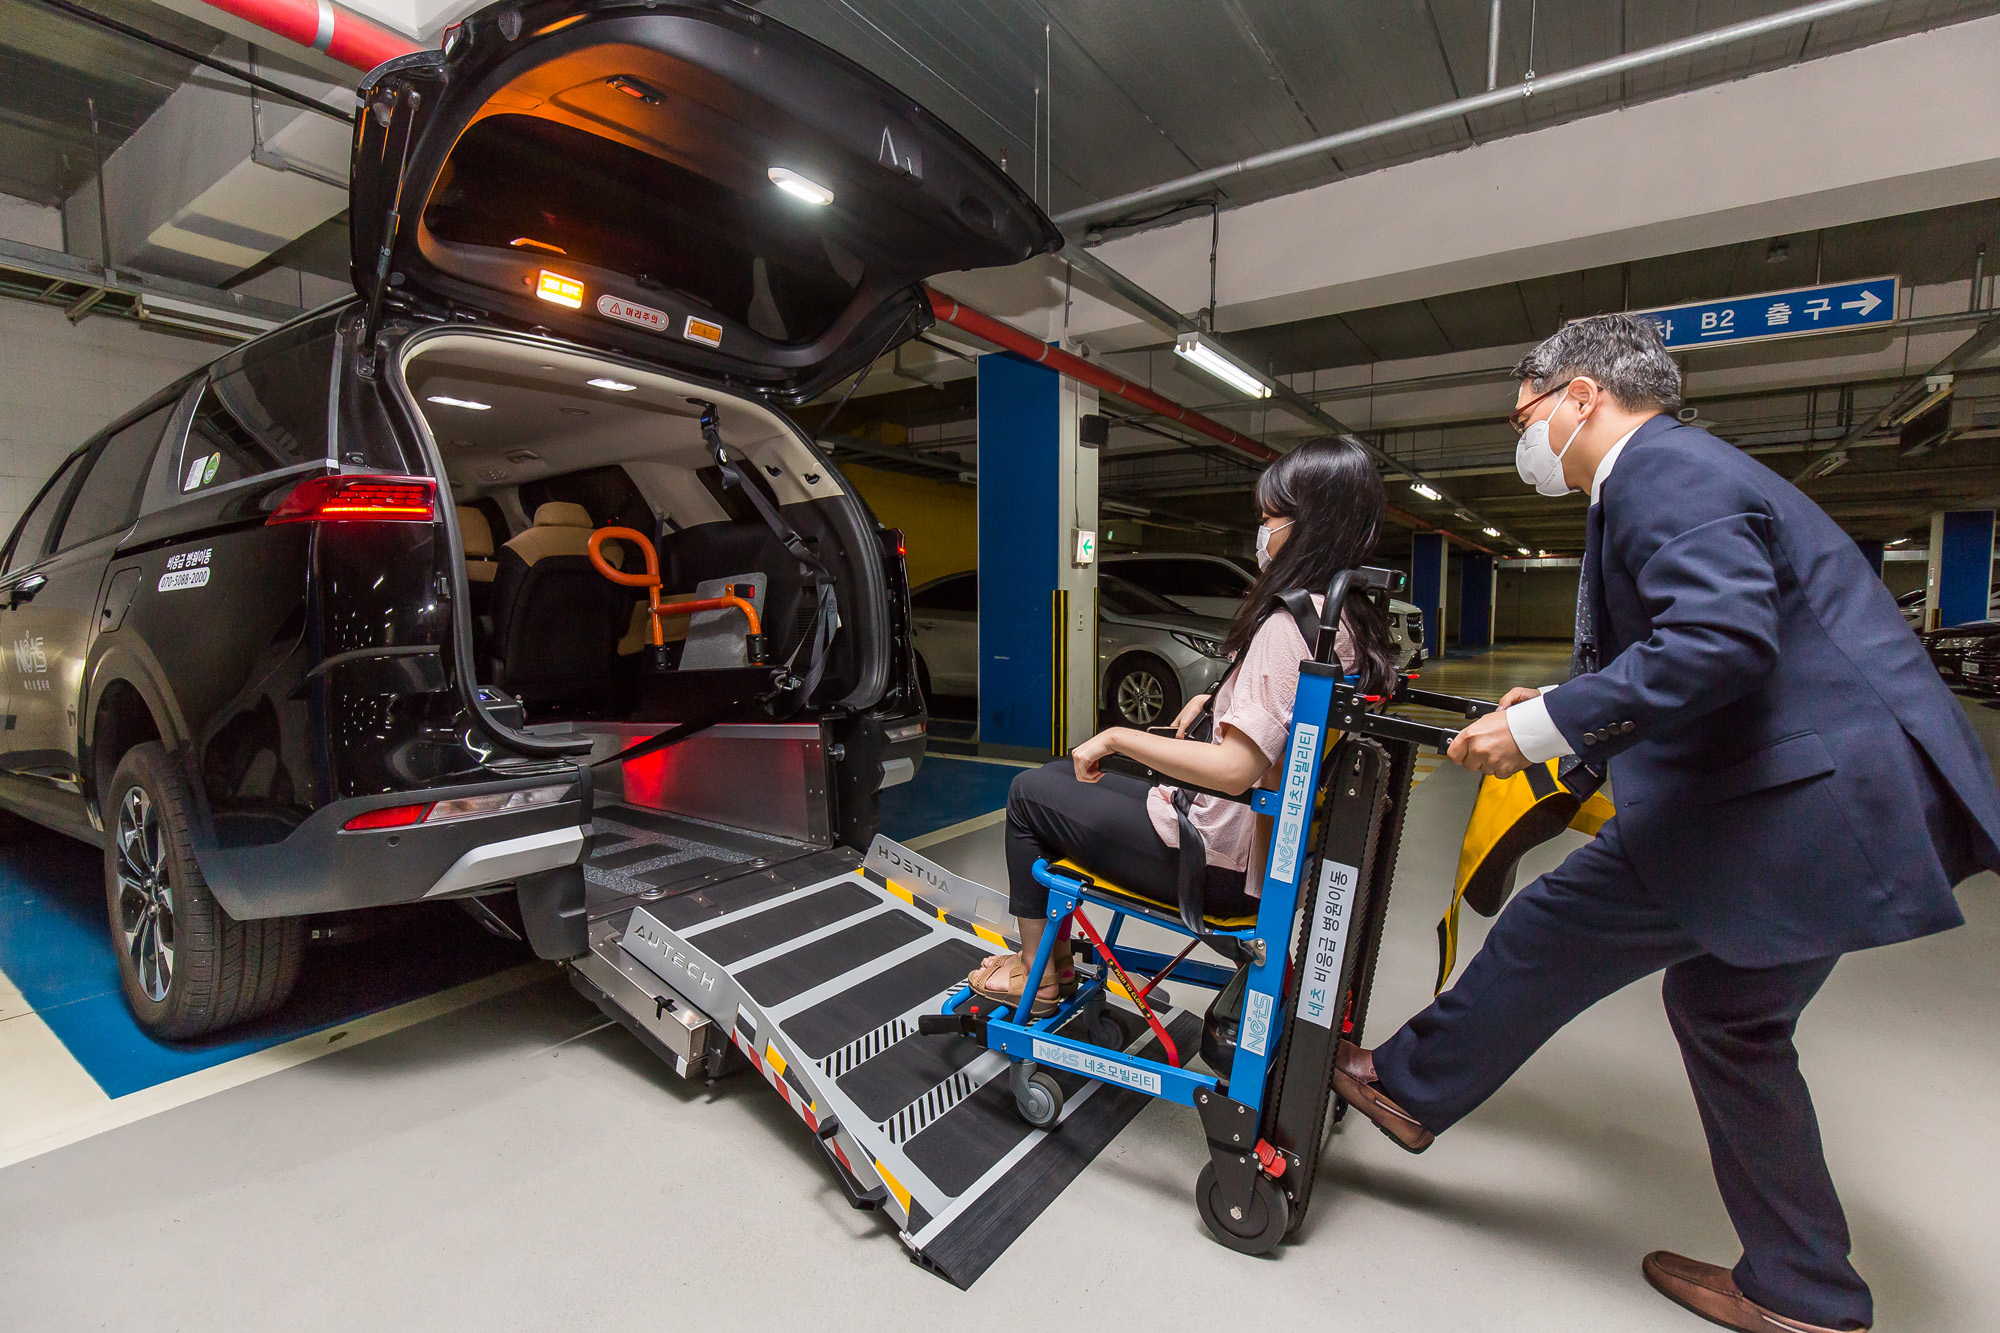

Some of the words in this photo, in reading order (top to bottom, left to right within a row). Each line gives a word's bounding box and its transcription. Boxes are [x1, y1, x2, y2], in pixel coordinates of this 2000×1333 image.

[625, 306, 659, 324] 머리주의
[1701, 309, 1734, 330] B2
[166, 553, 187, 570] 비응급
[185, 548, 213, 567] 병원이동
[1287, 731, 1315, 816] 네츠모빌리티
[1322, 870, 1348, 932] 병원이동
[634, 924, 715, 992] AUTECH
[1313, 937, 1337, 983] 비응급
[1114, 968, 1127, 984] PUSH
[1125, 982, 1133, 992] TO
[1131, 991, 1146, 1010] CLOSE
[1307, 987, 1326, 1017] 네츠
[1084, 1058, 1155, 1090] 네츠모빌리티
